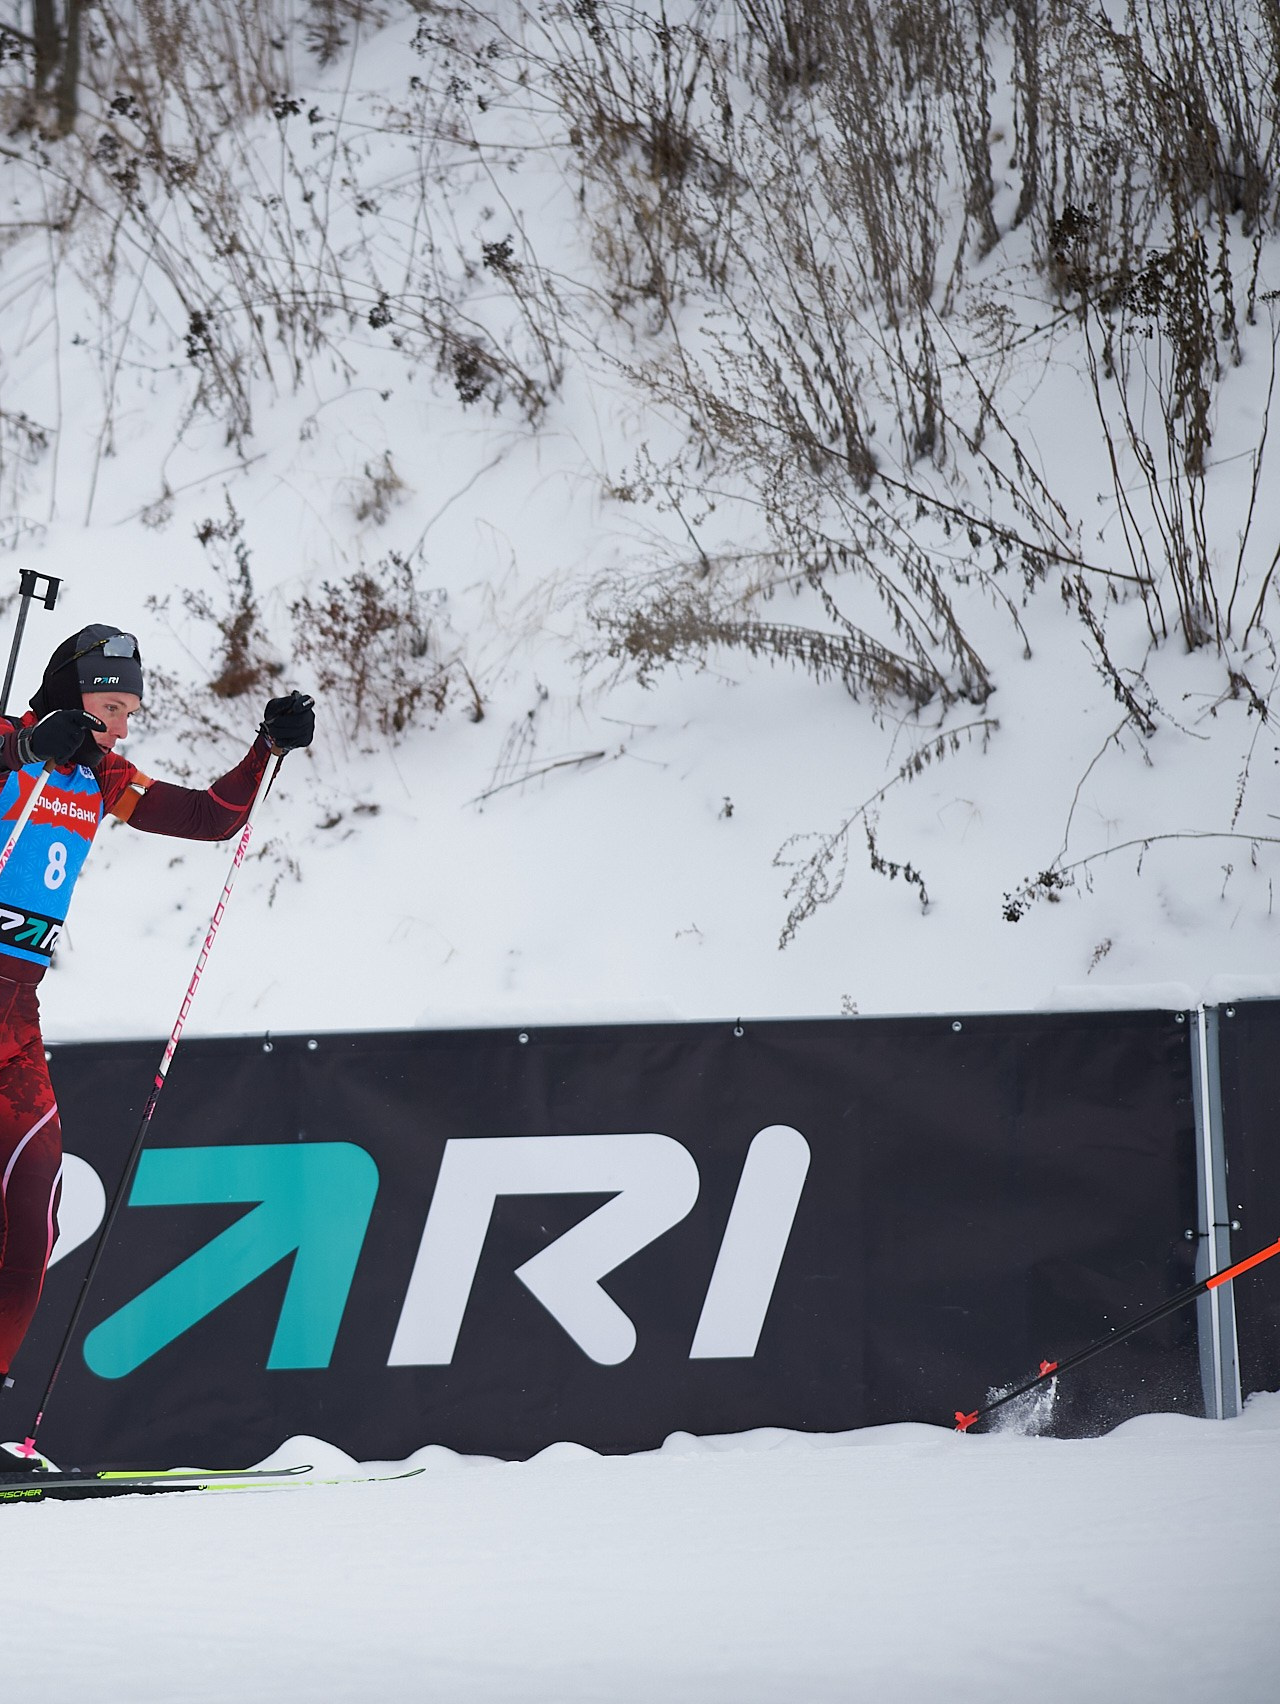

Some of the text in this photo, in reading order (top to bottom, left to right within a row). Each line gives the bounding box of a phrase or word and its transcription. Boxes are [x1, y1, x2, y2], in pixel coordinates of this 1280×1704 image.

[93, 676, 120, 685] PARI
[34, 796, 96, 824] льфа Банк
[44, 842, 67, 890] 8
